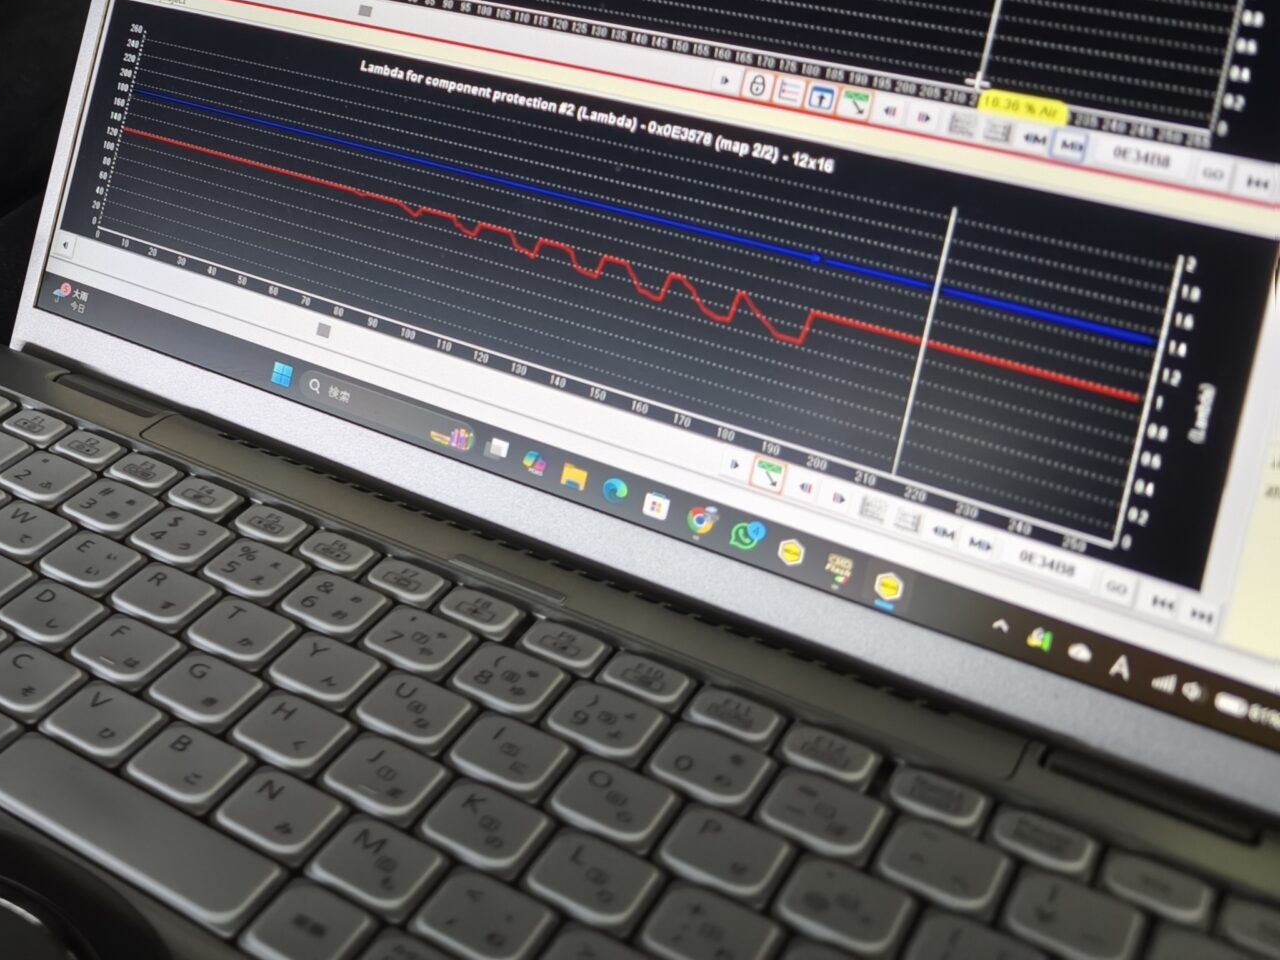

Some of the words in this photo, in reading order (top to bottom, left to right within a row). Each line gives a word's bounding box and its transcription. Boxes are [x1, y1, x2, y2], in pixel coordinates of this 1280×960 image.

[477, 4, 492, 16] 100
[514, 12, 530, 23] 110
[552, 18, 568, 30] 120
[591, 25, 607, 38] 130
[672, 39, 689, 52] 150
[360, 60, 404, 80] Lambda
[406, 70, 424, 84] for
[425, 74, 491, 98] component
[492, 89, 557, 114] protection
[559, 102, 575, 117] #2
[577, 106, 638, 133] (Lambda)
[715, 134, 749, 157] (map
[752, 143, 779, 164] 2/2)
[792, 152, 835, 174] 12x16
[70, 301, 86, 314] 今日
[148, 247, 158, 256] 20
[177, 256, 186, 266] 30
[207, 266, 217, 276] 40
[237, 275, 247, 286] 50
[301, 295, 311, 307] 70
[401, 327, 416, 340] 100
[436, 338, 452, 352] 110
[473, 350, 489, 364] 120
[511, 362, 528, 376] 130
[550, 374, 566, 389] 140
[590, 387, 607, 401] 150
[632, 400, 649, 415] 160
[673, 413, 692, 428] 170
[717, 427, 735, 442] 180
[762, 441, 781, 456] 190
[806, 455, 828, 471] 200
[854, 470, 876, 487] 210
[328, 385, 350, 404] 検索
[11, 507, 36, 524] W
[77, 539, 95, 553] E
[147, 572, 168, 586] R
[35, 588, 56, 603] D
[223, 606, 247, 619] T
[12, 654, 34, 669] C
[1109, 654, 1130, 682] A
[188, 663, 211, 679] G
[395, 682, 417, 699] U
[90, 692, 113, 708] V
[272, 703, 297, 721] H
[170, 735, 192, 753] B
[262, 779, 284, 801] N
[352, 829, 388, 854] M
